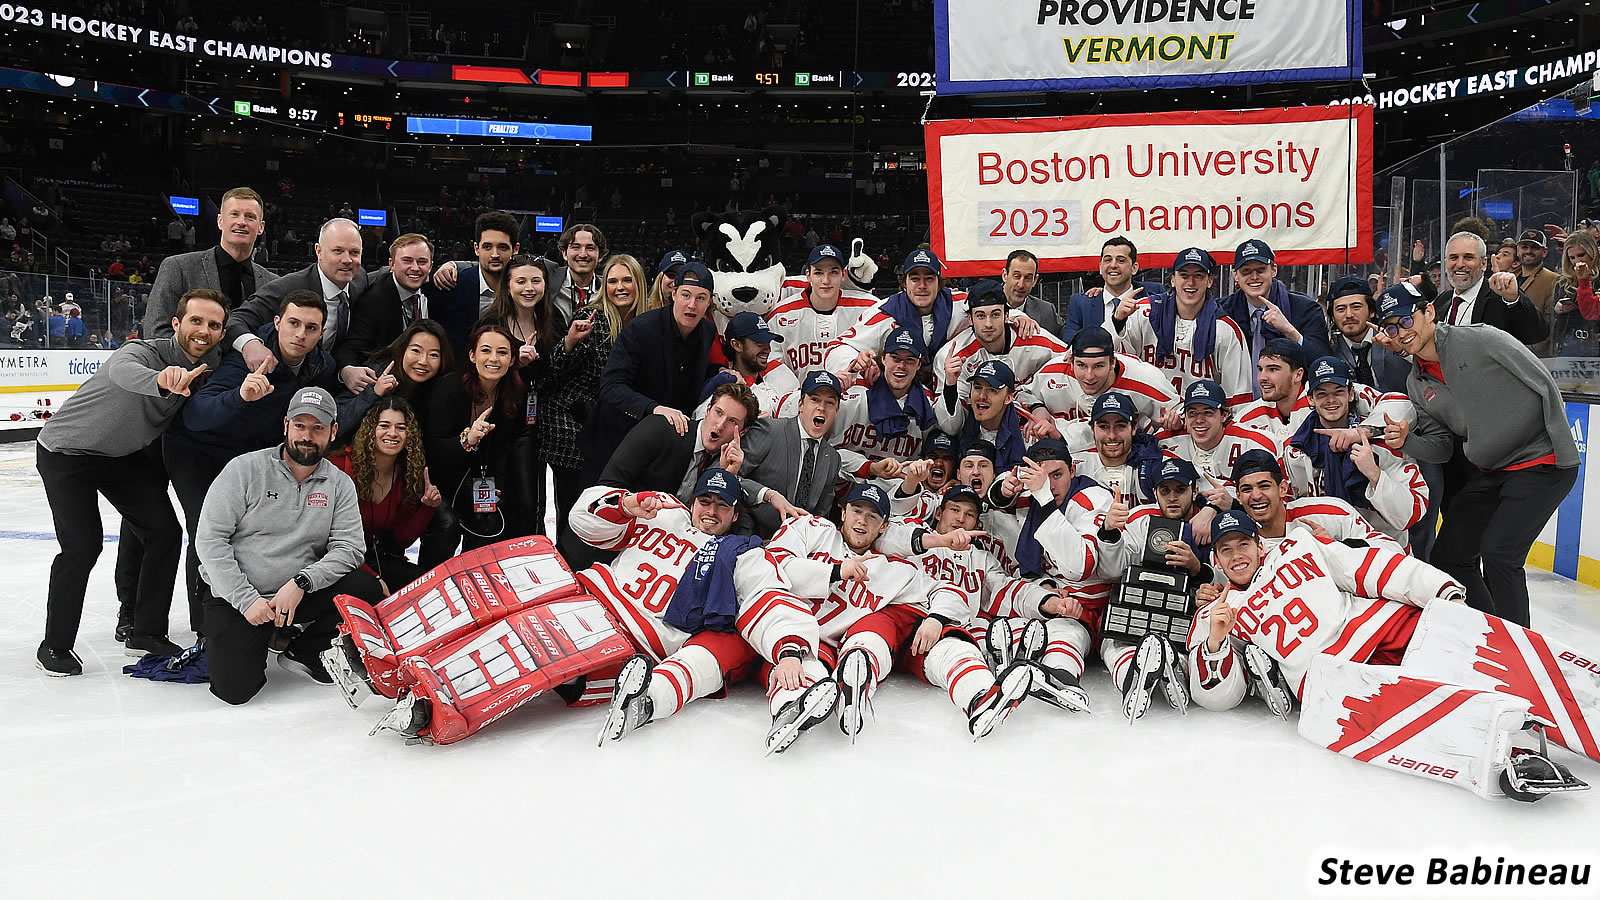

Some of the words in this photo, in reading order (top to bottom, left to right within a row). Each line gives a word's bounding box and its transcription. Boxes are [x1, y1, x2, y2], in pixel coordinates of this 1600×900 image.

[1037, 0, 1256, 26] PROVIDENCE
[51, 12, 143, 44] HOCKEY
[149, 30, 197, 53] EAST
[203, 39, 333, 69] CHAMPIONS
[1063, 33, 1237, 65] VERMONT
[711, 74, 734, 83] Bank
[755, 73, 779, 85] 9:57
[811, 74, 835, 83] Bank
[1379, 79, 1461, 109] HOCKEY
[1467, 69, 1518, 95] EAST
[252, 105, 278, 115] Bank
[288, 107, 318, 122] 9:57
[978, 151, 1110, 186] Boston
[1127, 141, 1320, 183] University
[989, 207, 1069, 238] 2023
[1092, 197, 1315, 239] Champions
[787, 342, 828, 371] BOS
[1228, 443, 1242, 467] A
[1279, 538, 1298, 556] A
[400, 570, 437, 597] BAUER
[472, 571, 500, 607] BAUER
[622, 562, 678, 614] 30
[528, 615, 560, 657] BAUER
[1260, 597, 1319, 659] 29
[1388, 754, 1459, 780] BAUER
